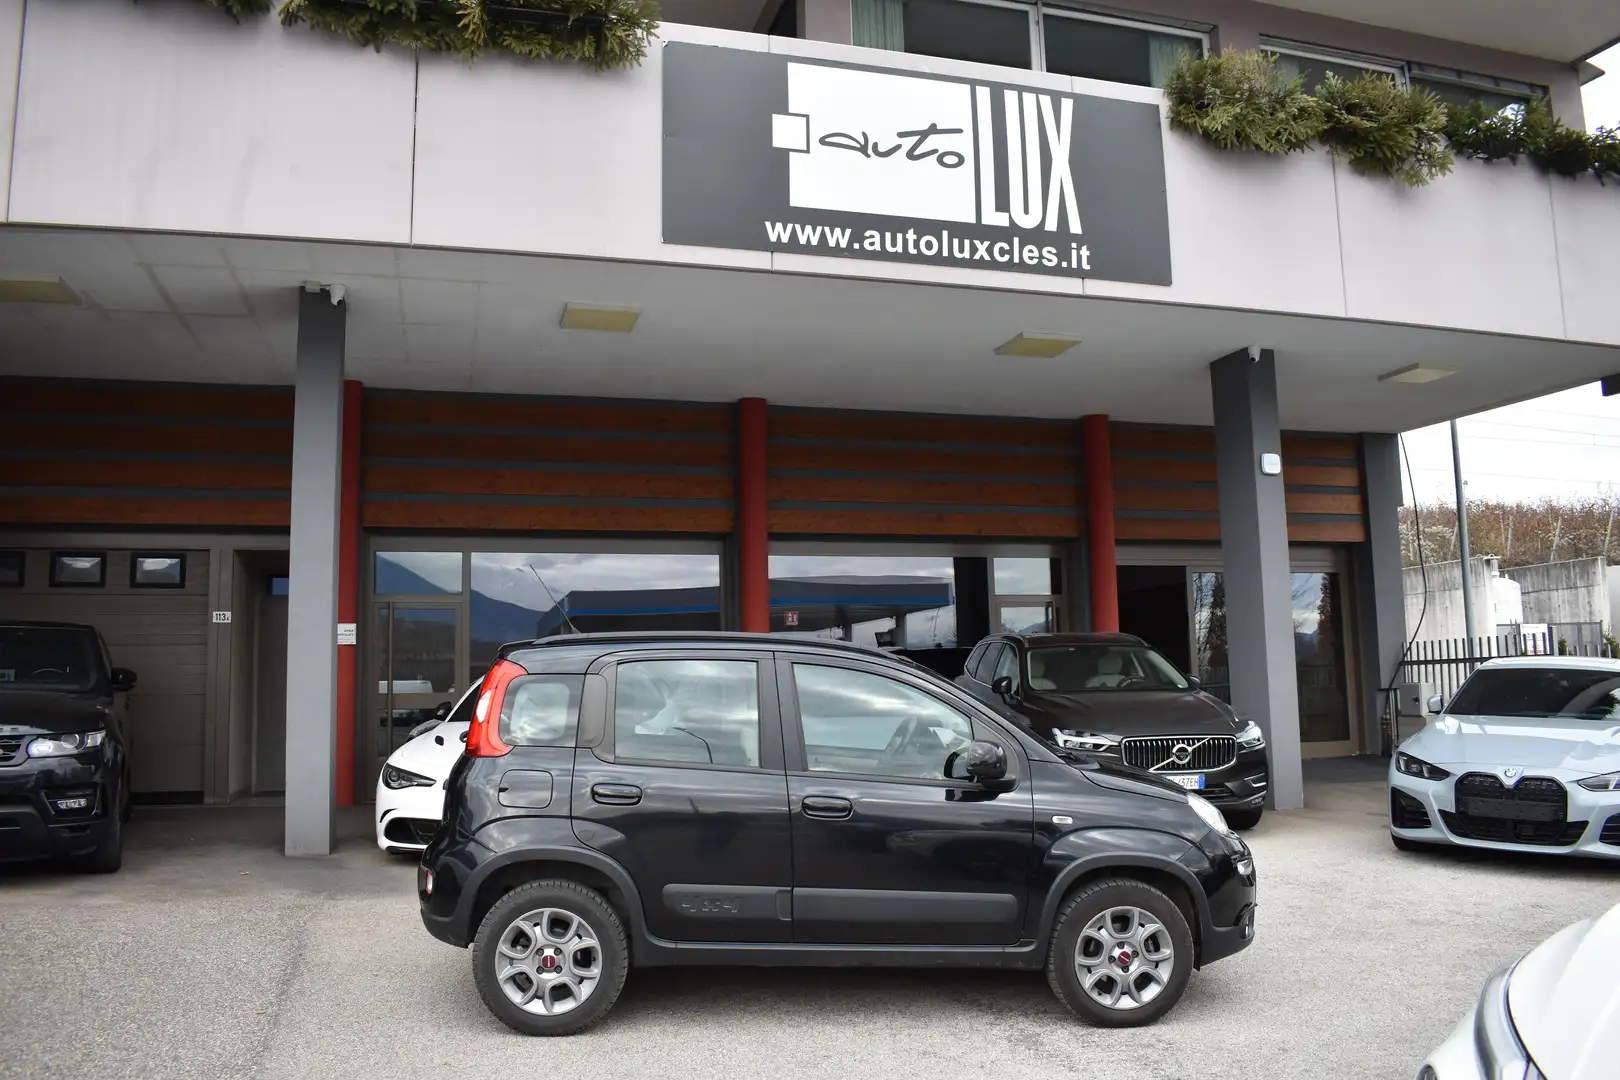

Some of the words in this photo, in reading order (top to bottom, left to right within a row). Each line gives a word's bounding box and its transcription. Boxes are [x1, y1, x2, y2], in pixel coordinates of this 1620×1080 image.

[818, 122, 965, 169] auto
[975, 85, 1083, 235] LUX
[764, 221, 1092, 270] www.autoluxcles.it
